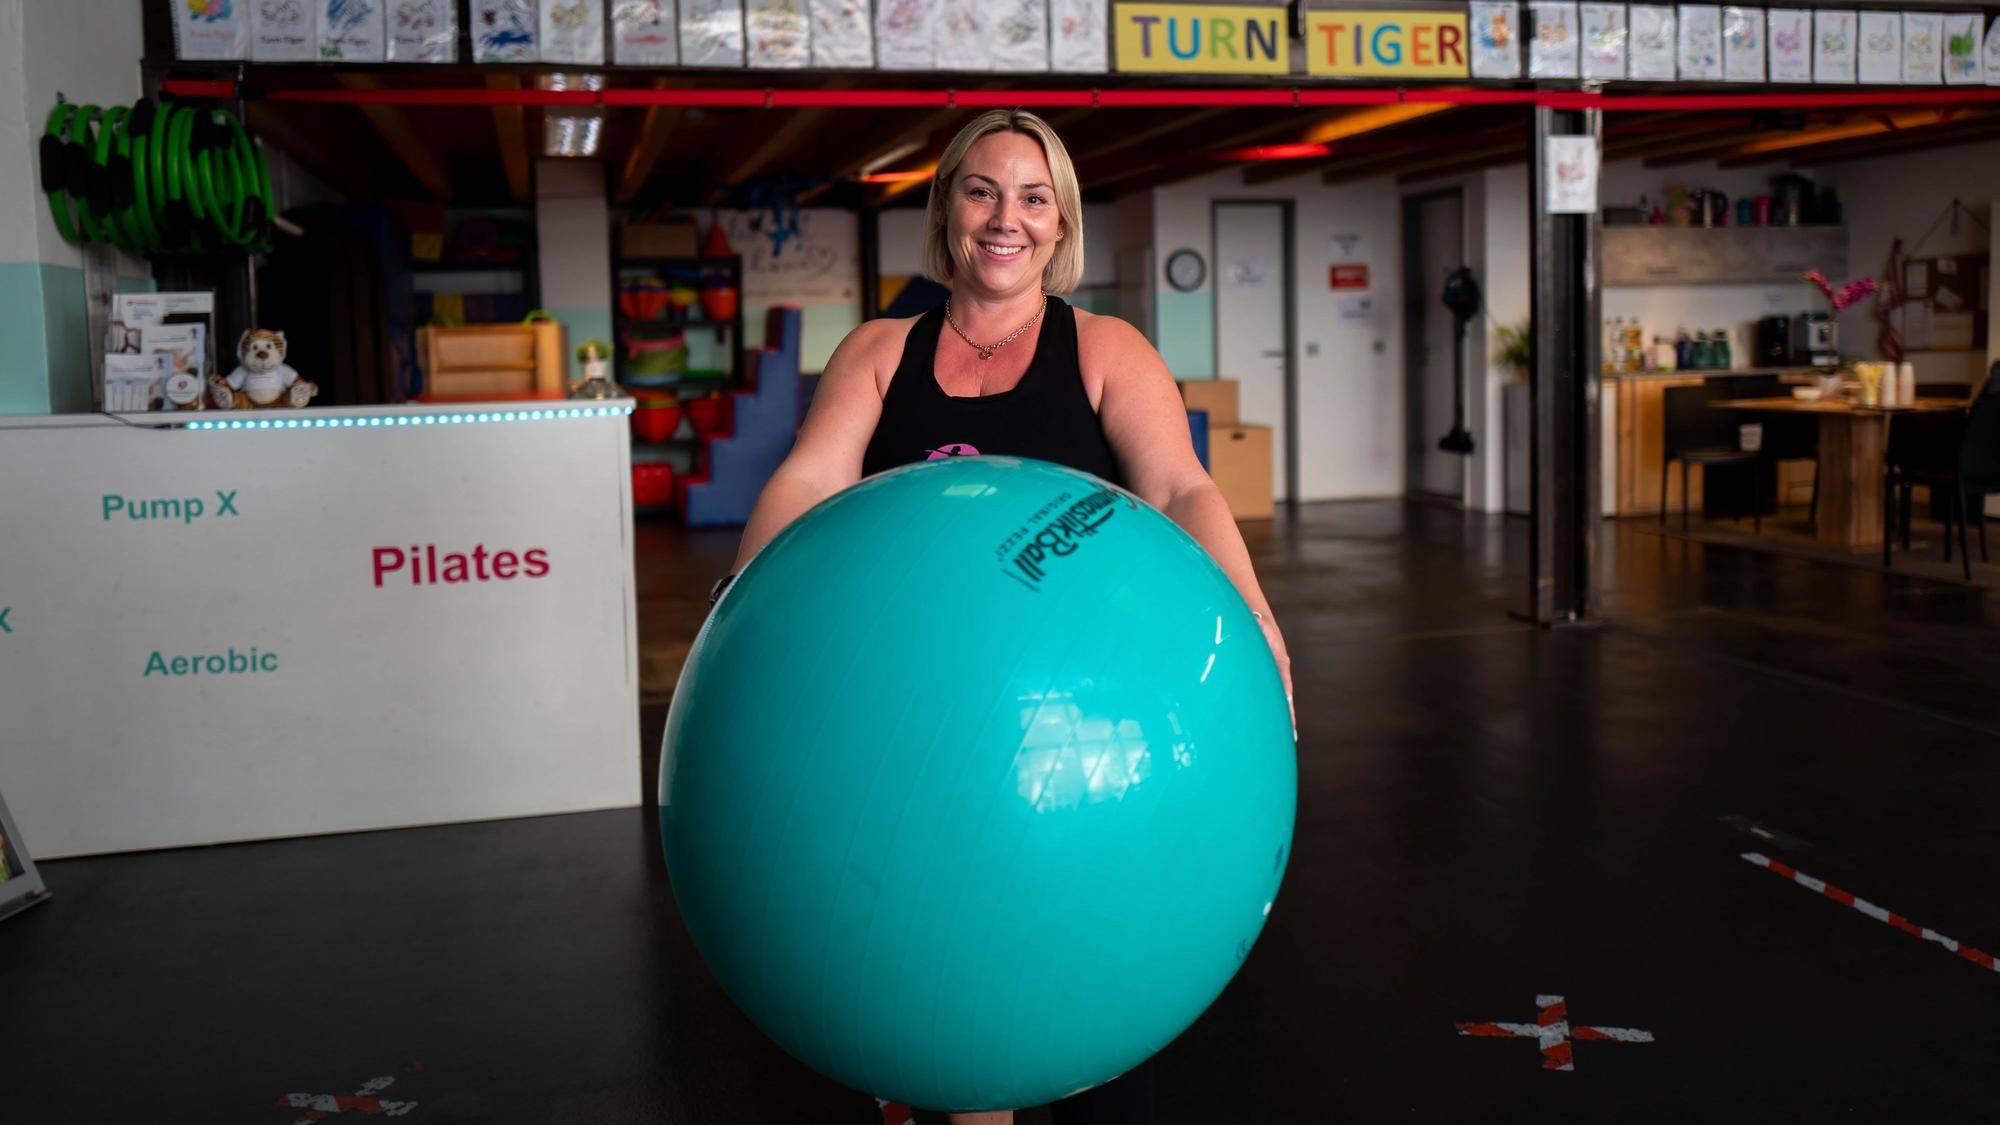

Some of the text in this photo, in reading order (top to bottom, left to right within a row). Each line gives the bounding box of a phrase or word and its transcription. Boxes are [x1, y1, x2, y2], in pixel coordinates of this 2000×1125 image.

[1131, 16, 1464, 66] TURN TIGER
[102, 490, 238, 524] Pump X
[1026, 492, 1072, 525] ORIGINAL
[371, 543, 551, 588] Pilates
[144, 648, 278, 677] Aerobic
